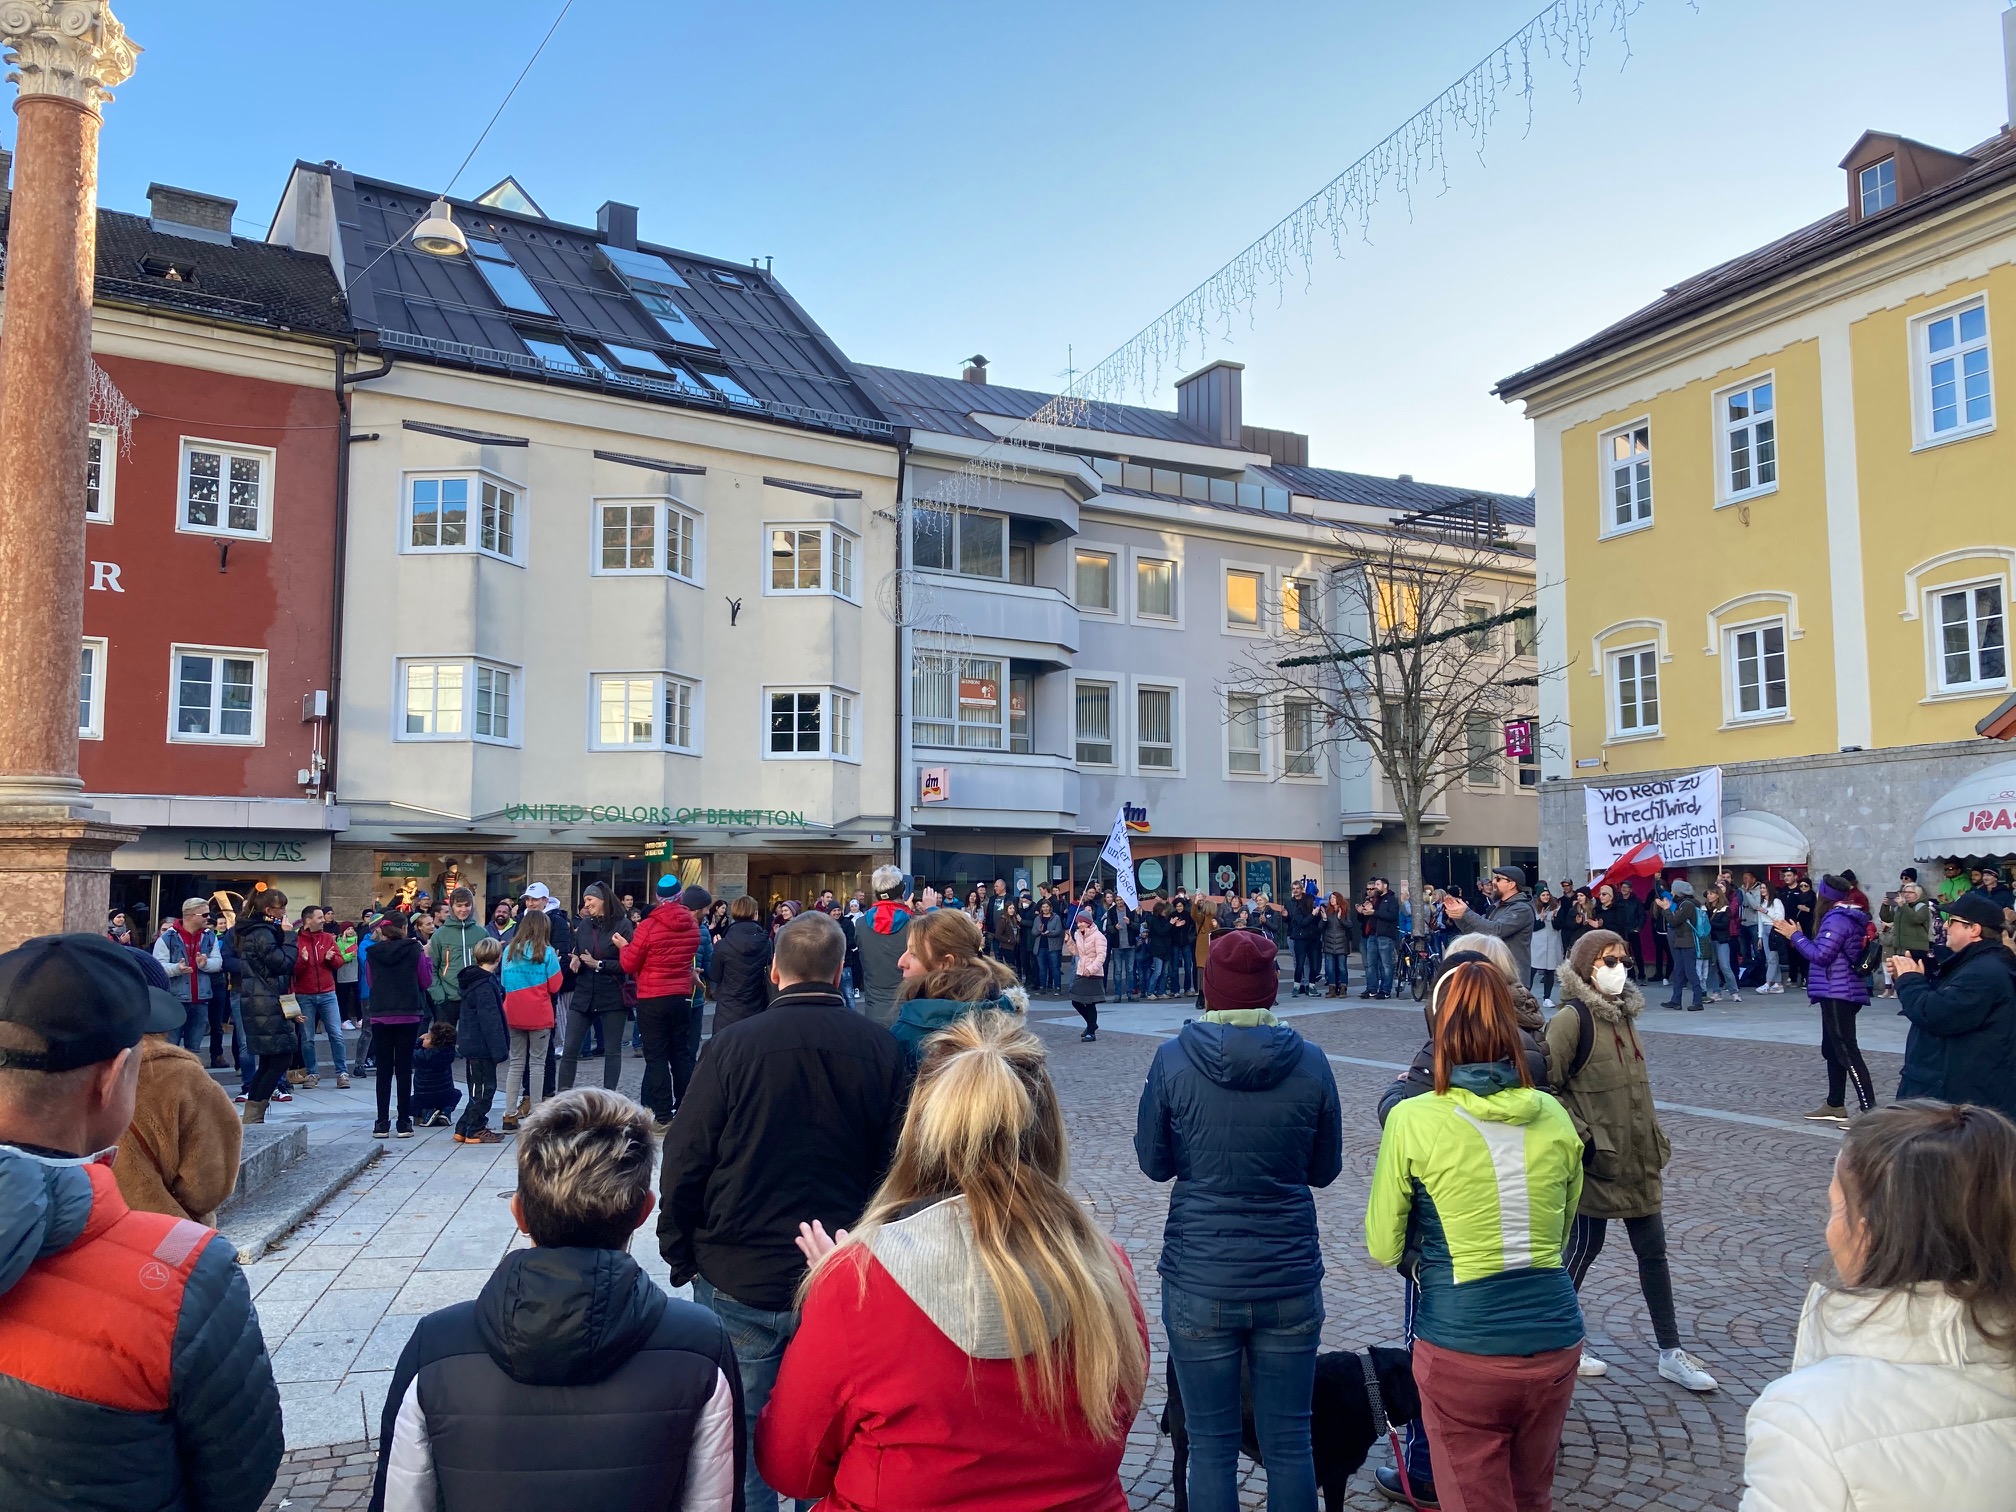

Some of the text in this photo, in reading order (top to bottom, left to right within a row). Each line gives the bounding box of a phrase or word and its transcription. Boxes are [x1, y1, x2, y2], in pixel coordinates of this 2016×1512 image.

[90, 560, 125, 593] R
[1509, 726, 1526, 753] T
[925, 773, 939, 788] dm
[505, 802, 584, 822] UNITED
[590, 805, 670, 823] COLORS
[676, 807, 701, 824] OF
[1123, 801, 1147, 821] dm
[1961, 808, 2016, 833] JOA
[1608, 819, 1717, 847] wird Widerstand
[184, 838, 307, 862] DOUGLAS
